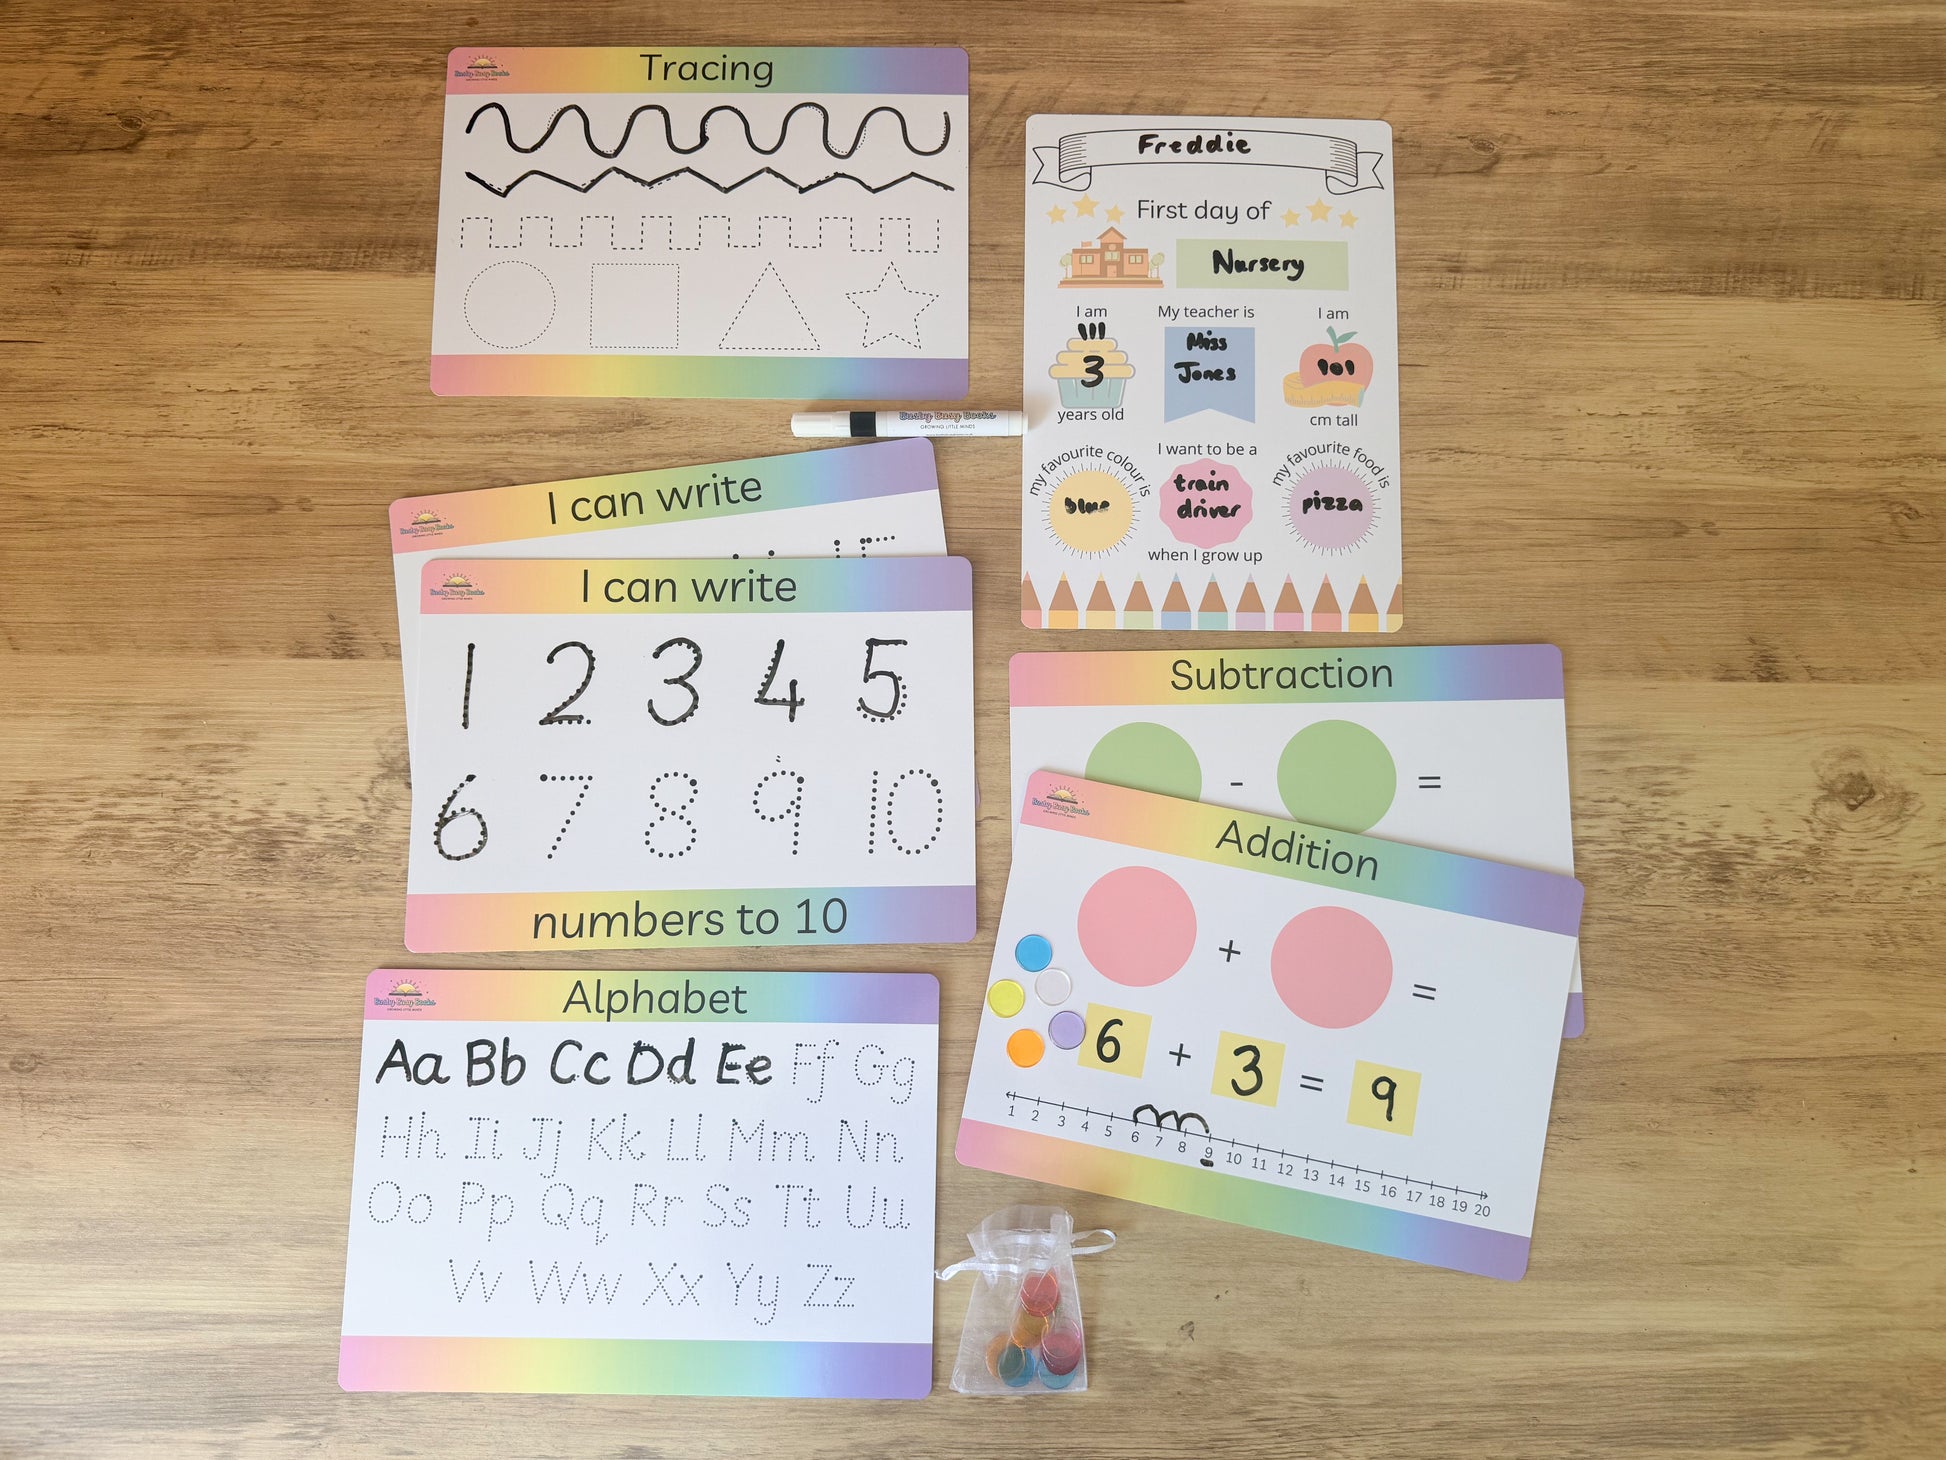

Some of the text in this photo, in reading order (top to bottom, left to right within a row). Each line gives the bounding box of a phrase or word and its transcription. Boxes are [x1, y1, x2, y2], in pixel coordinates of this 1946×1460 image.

[639, 53, 773, 89] Tracing
[1138, 131, 1252, 155] Freddie
[1138, 199, 1273, 225] First day of
[1212, 248, 1305, 282] Nursery
[1076, 305, 1108, 318] I am
[1158, 305, 1255, 322] My teacher is
[1318, 307, 1349, 320] I am
[1186, 329, 1228, 352] Miss
[1080, 354, 1105, 389] 3
[1173, 361, 1237, 384] Jones
[1317, 358, 1355, 376] 101
[1057, 408, 1124, 425] years old
[1309, 413, 1358, 427] cm tall
[1158, 442, 1257, 456] I want to be a
[1272, 442, 1390, 489] my favourite food is
[1029, 445, 1151, 498] my favourite colour is
[1173, 469, 1230, 493] train
[548, 472, 762, 525] I can write
[1064, 496, 1110, 515] blue
[1176, 497, 1242, 519] driver
[1302, 489, 1363, 515] pizza
[1147, 547, 1263, 566] when I grow up
[583, 568, 797, 603] I can write
[461, 637, 908, 730] 1 2 3 4 5
[1170, 657, 1393, 691] Subtraction
[433, 768, 943, 862] 6 7 8 9 10
[1215, 819, 1378, 881] Addition
[533, 897, 848, 939] numbers to 10
[562, 978, 748, 1023] Alphabet
[375, 1036, 918, 1105] Aa Bb Cc Dd Ee Ff Gg
[1096, 1018, 1124, 1064] 6
[1231, 1044, 1264, 1097] 3
[1371, 1075, 1397, 1122] 9
[379, 1109, 905, 1179] Hh Ii Jj Kk Ll Mm Nn
[1008, 1105, 1491, 1218] 1 2 3 4 5 6 7 8 9 10 11 12 13 14 15 16 17 18 19 20
[366, 1179, 911, 1246] Oo Pp Qq Rr Ss Tt Uu
[528, 1259, 623, 1306] Ww
[641, 1262, 705, 1307] Xx
[725, 1261, 781, 1327] Yy
[801, 1262, 857, 1308] Zz
